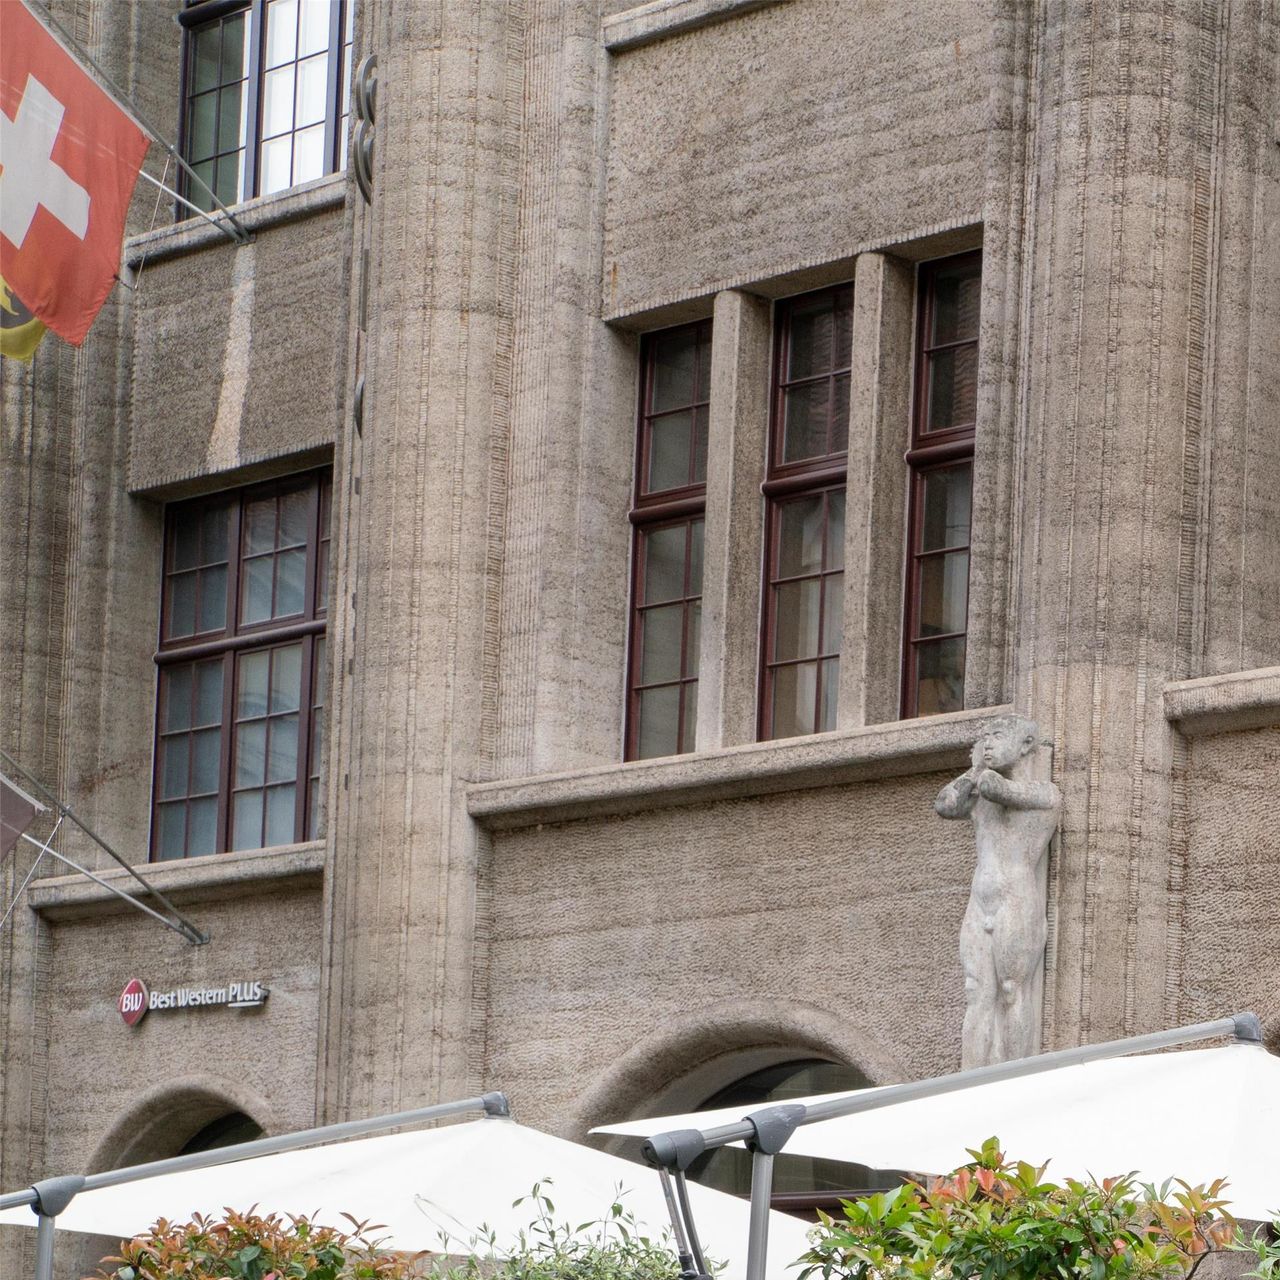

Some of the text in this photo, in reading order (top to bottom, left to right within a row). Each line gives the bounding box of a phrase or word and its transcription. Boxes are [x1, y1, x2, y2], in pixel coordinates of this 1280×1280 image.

[122, 992, 143, 1013] BW
[149, 981, 261, 1010] Best Western PLUS
